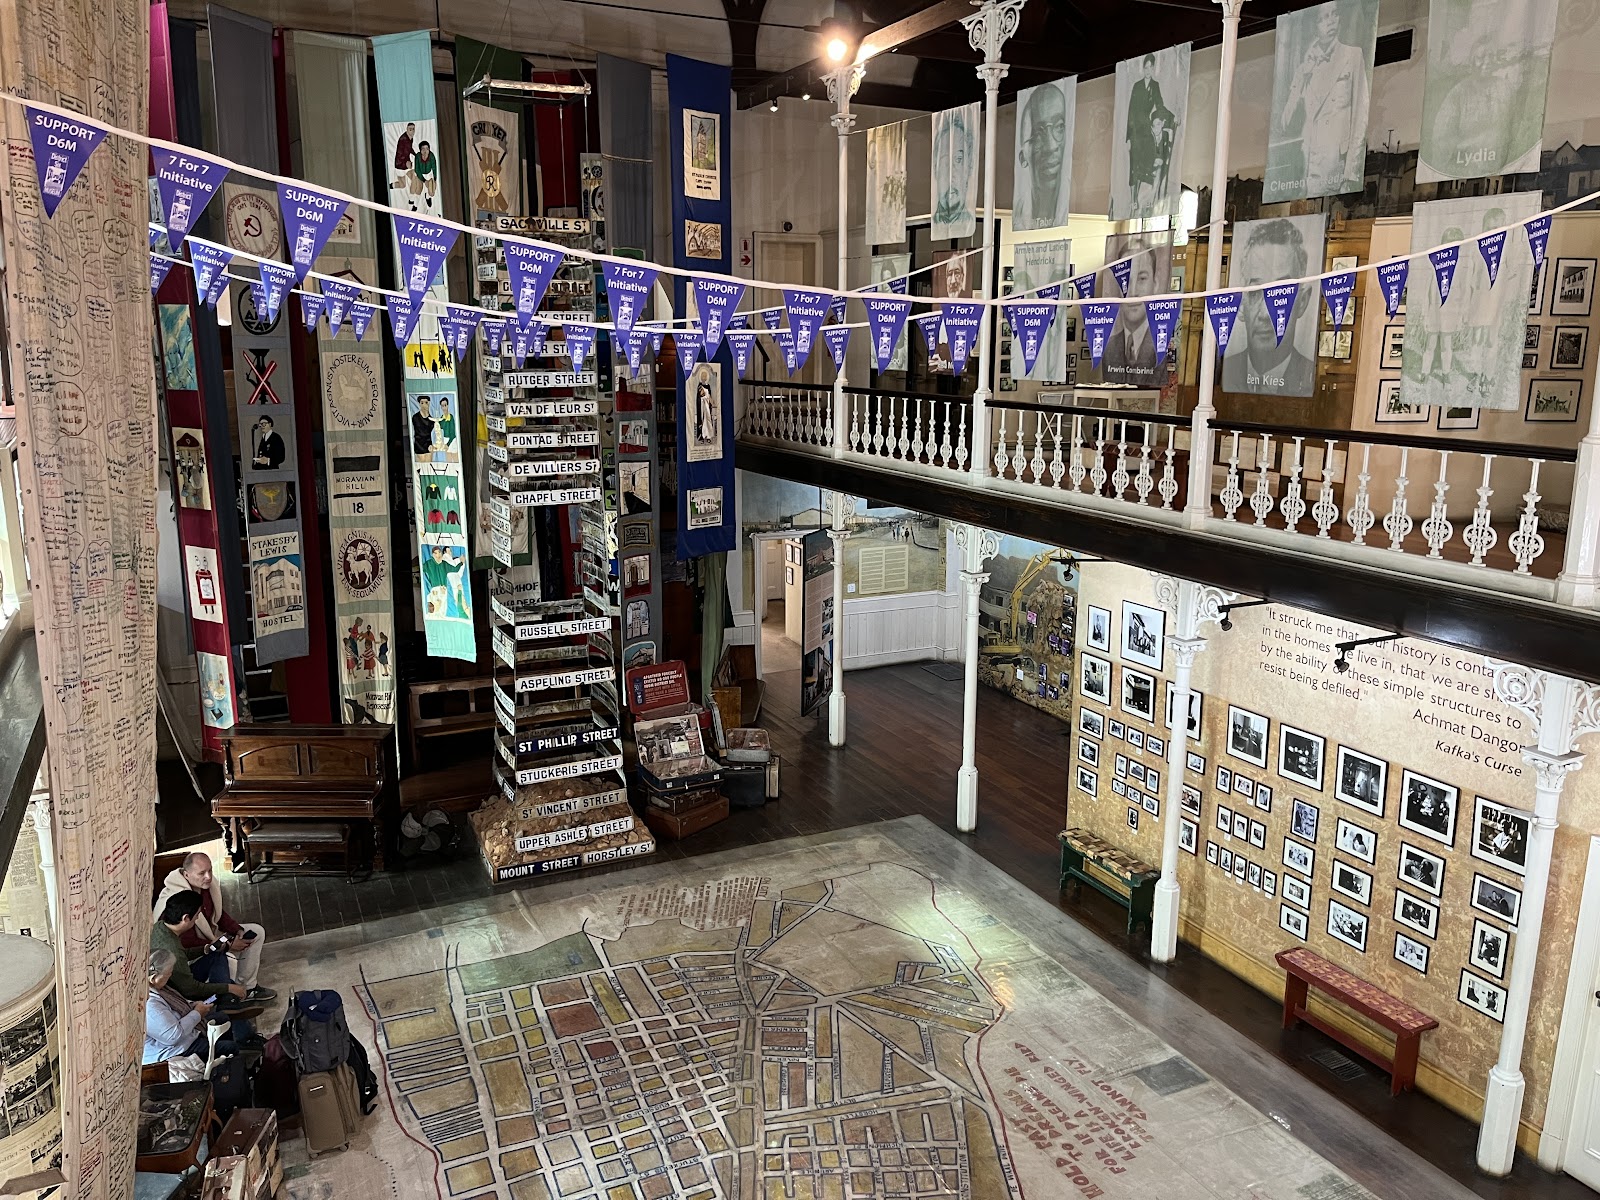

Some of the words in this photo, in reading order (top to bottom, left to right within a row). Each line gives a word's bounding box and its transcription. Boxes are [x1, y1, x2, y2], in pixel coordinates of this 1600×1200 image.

[35, 114, 96, 141] SUPPORT
[47, 135, 77, 152] D6M
[1456, 148, 1496, 166] Lydia
[168, 156, 177, 165] 7
[179, 158, 199, 172] For
[201, 165, 209, 175] 7
[160, 168, 213, 192] Initiative
[285, 189, 339, 212] SUPPORT
[296, 207, 323, 223] D6M
[408, 222, 415, 231] 7
[417, 224, 434, 236] For
[437, 229, 443, 237] 7
[500, 219, 569, 230] SACVILLE
[574, 221, 587, 231] ST
[1529, 228, 1549, 239] Initiative
[400, 235, 446, 253] Initiative
[1481, 234, 1503, 247] SUPPORT
[510, 246, 556, 263] SUPPORT
[1488, 246, 1498, 254] D6M
[193, 253, 225, 267] Initiative
[1436, 259, 1456, 270] Initiative
[263, 265, 295, 279] SUPPORT
[520, 262, 542, 274] D6M
[615, 267, 621, 275] 7
[622, 268, 636, 278] For
[638, 271, 644, 279] 7
[1380, 263, 1406, 275] SUPPORT
[270, 276, 286, 285] D6M
[1386, 274, 1401, 283] D6M
[608, 279, 648, 293] Initiative
[698, 281, 739, 295] SUPPORT
[1266, 286, 1295, 297] SUPPORT
[325, 291, 354, 302] Initiative
[390, 297, 411, 306] SUPPO
[707, 295, 727, 306] D6M
[800, 294, 814, 304] For
[815, 296, 821, 304] 7
[1218, 296, 1229, 304] For
[1274, 298, 1288, 306] D6M
[789, 306, 824, 317] Initiative
[870, 301, 906, 312] SUPPORT
[956, 306, 969, 315] For
[1017, 307, 1050, 316] SUPPORT
[1149, 302, 1178, 311] SUPPORT
[1210, 306, 1238, 315] Initiative
[451, 318, 477, 327] Initiative
[878, 314, 896, 323] D6M
[946, 318, 978, 326] Initiative
[1024, 318, 1041, 326] D6M
[1108, 365, 1125, 374] Irwin
[509, 375, 550, 385] RUTGER
[555, 374, 594, 385] STREET
[1247, 374, 1260, 385] Ben
[1263, 375, 1285, 387] Kies
[511, 405, 532, 415] VAN
[536, 404, 549, 415] DE
[554, 403, 580, 414] LEUR
[584, 403, 594, 413] ST
[512, 435, 552, 445] PONTAC
[557, 433, 595, 444] STREET
[515, 465, 529, 474] DE
[533, 463, 581, 473] VILLIERS
[585, 461, 597, 472] ST
[516, 494, 556, 504] CHAPEL
[560, 490, 597, 501] STREET
[352, 502, 364, 513] 18
[252, 535, 297, 550] STAKESBY
[260, 546, 287, 558] LEWIS
[263, 615, 297, 628] HOSTEL
[520, 625, 565, 637] RUSSELL
[571, 620, 606, 632] STREET
[1279, 613, 1312, 630] struck
[1315, 624, 1333, 635] me
[1337, 626, 1359, 641] that
[1392, 639, 1437, 666] history
[1441, 654, 1451, 666] is
[1262, 625, 1271, 636] in
[1274, 628, 1291, 642] the
[1294, 633, 1330, 653] homes
[1357, 650, 1377, 667] live
[1381, 657, 1395, 673] in,
[1400, 664, 1425, 680] that
[1432, 674, 1452, 687] we
[1457, 684, 1479, 695] are
[520, 676, 571, 690] ASPELING
[575, 670, 611, 683] STREET
[1260, 661, 1287, 677] resist
[1289, 668, 1318, 691] being
[1260, 641, 1273, 656] by
[1276, 647, 1292, 660] the
[1296, 652, 1327, 673] ability
[1348, 668, 1379, 687] these
[1383, 679, 1425, 700] simple
[1430, 693, 1501, 724] structures
[1506, 715, 1522, 730] to
[1413, 708, 1466, 736] Achmat
[1471, 725, 1526, 753] Dangor
[519, 741, 532, 752] ST
[538, 735, 577, 749] PHILLIP
[582, 728, 618, 742] STREET
[1435, 740, 1481, 763] Kafka's
[1484, 756, 1523, 777] Curse
[520, 766, 578, 783] STUCKERIS
[581, 758, 619, 773] STREET
[523, 809, 533, 818] ST
[537, 801, 577, 816] VINCENT
[583, 792, 620, 808] STREET
[519, 836, 550, 849] UPPER
[554, 828, 592, 843] ASHLEY
[594, 819, 630, 835] STREET
[500, 864, 535, 879] MOUNT
[542, 856, 579, 872] STREET
[587, 846, 637, 863] HORSTLEY
[640, 842, 652, 853] ST
[1063, 1057, 1092, 1076] FLY
[1091, 1079, 1148, 1121] CANNOT
[1009, 1117, 1053, 1150] FAST
[1074, 1132, 1094, 1145] IF
[1062, 1142, 1084, 1161] TO
[1099, 1132, 1136, 1161] LIFE
[1095, 1149, 1127, 1175] FOR
[1056, 1157, 1105, 1199] HOLD
